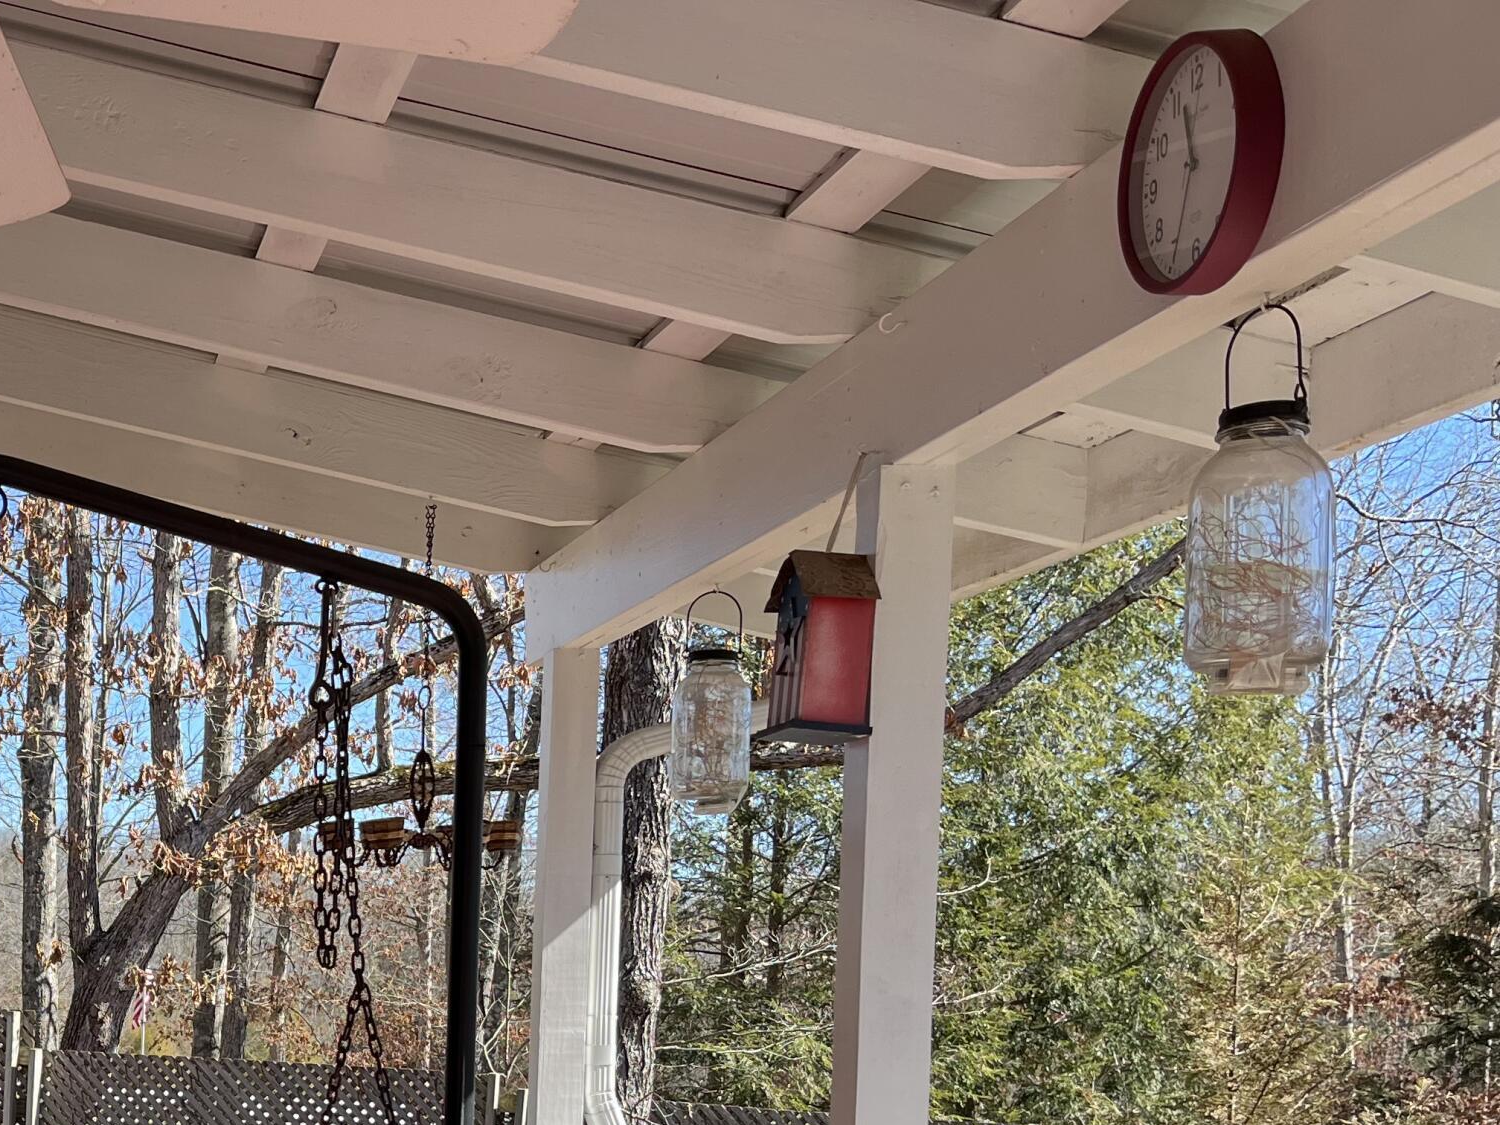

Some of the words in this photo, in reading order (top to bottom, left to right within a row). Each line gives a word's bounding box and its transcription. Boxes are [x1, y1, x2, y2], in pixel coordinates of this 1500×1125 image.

[1190, 63, 1204, 94] 12
[1172, 91, 1181, 120] 11
[1156, 132, 1169, 162] 10
[1149, 179, 1158, 205] 9
[1155, 218, 1164, 243] 8
[1171, 237, 1179, 265] 7
[1191, 237, 1201, 263] 6
